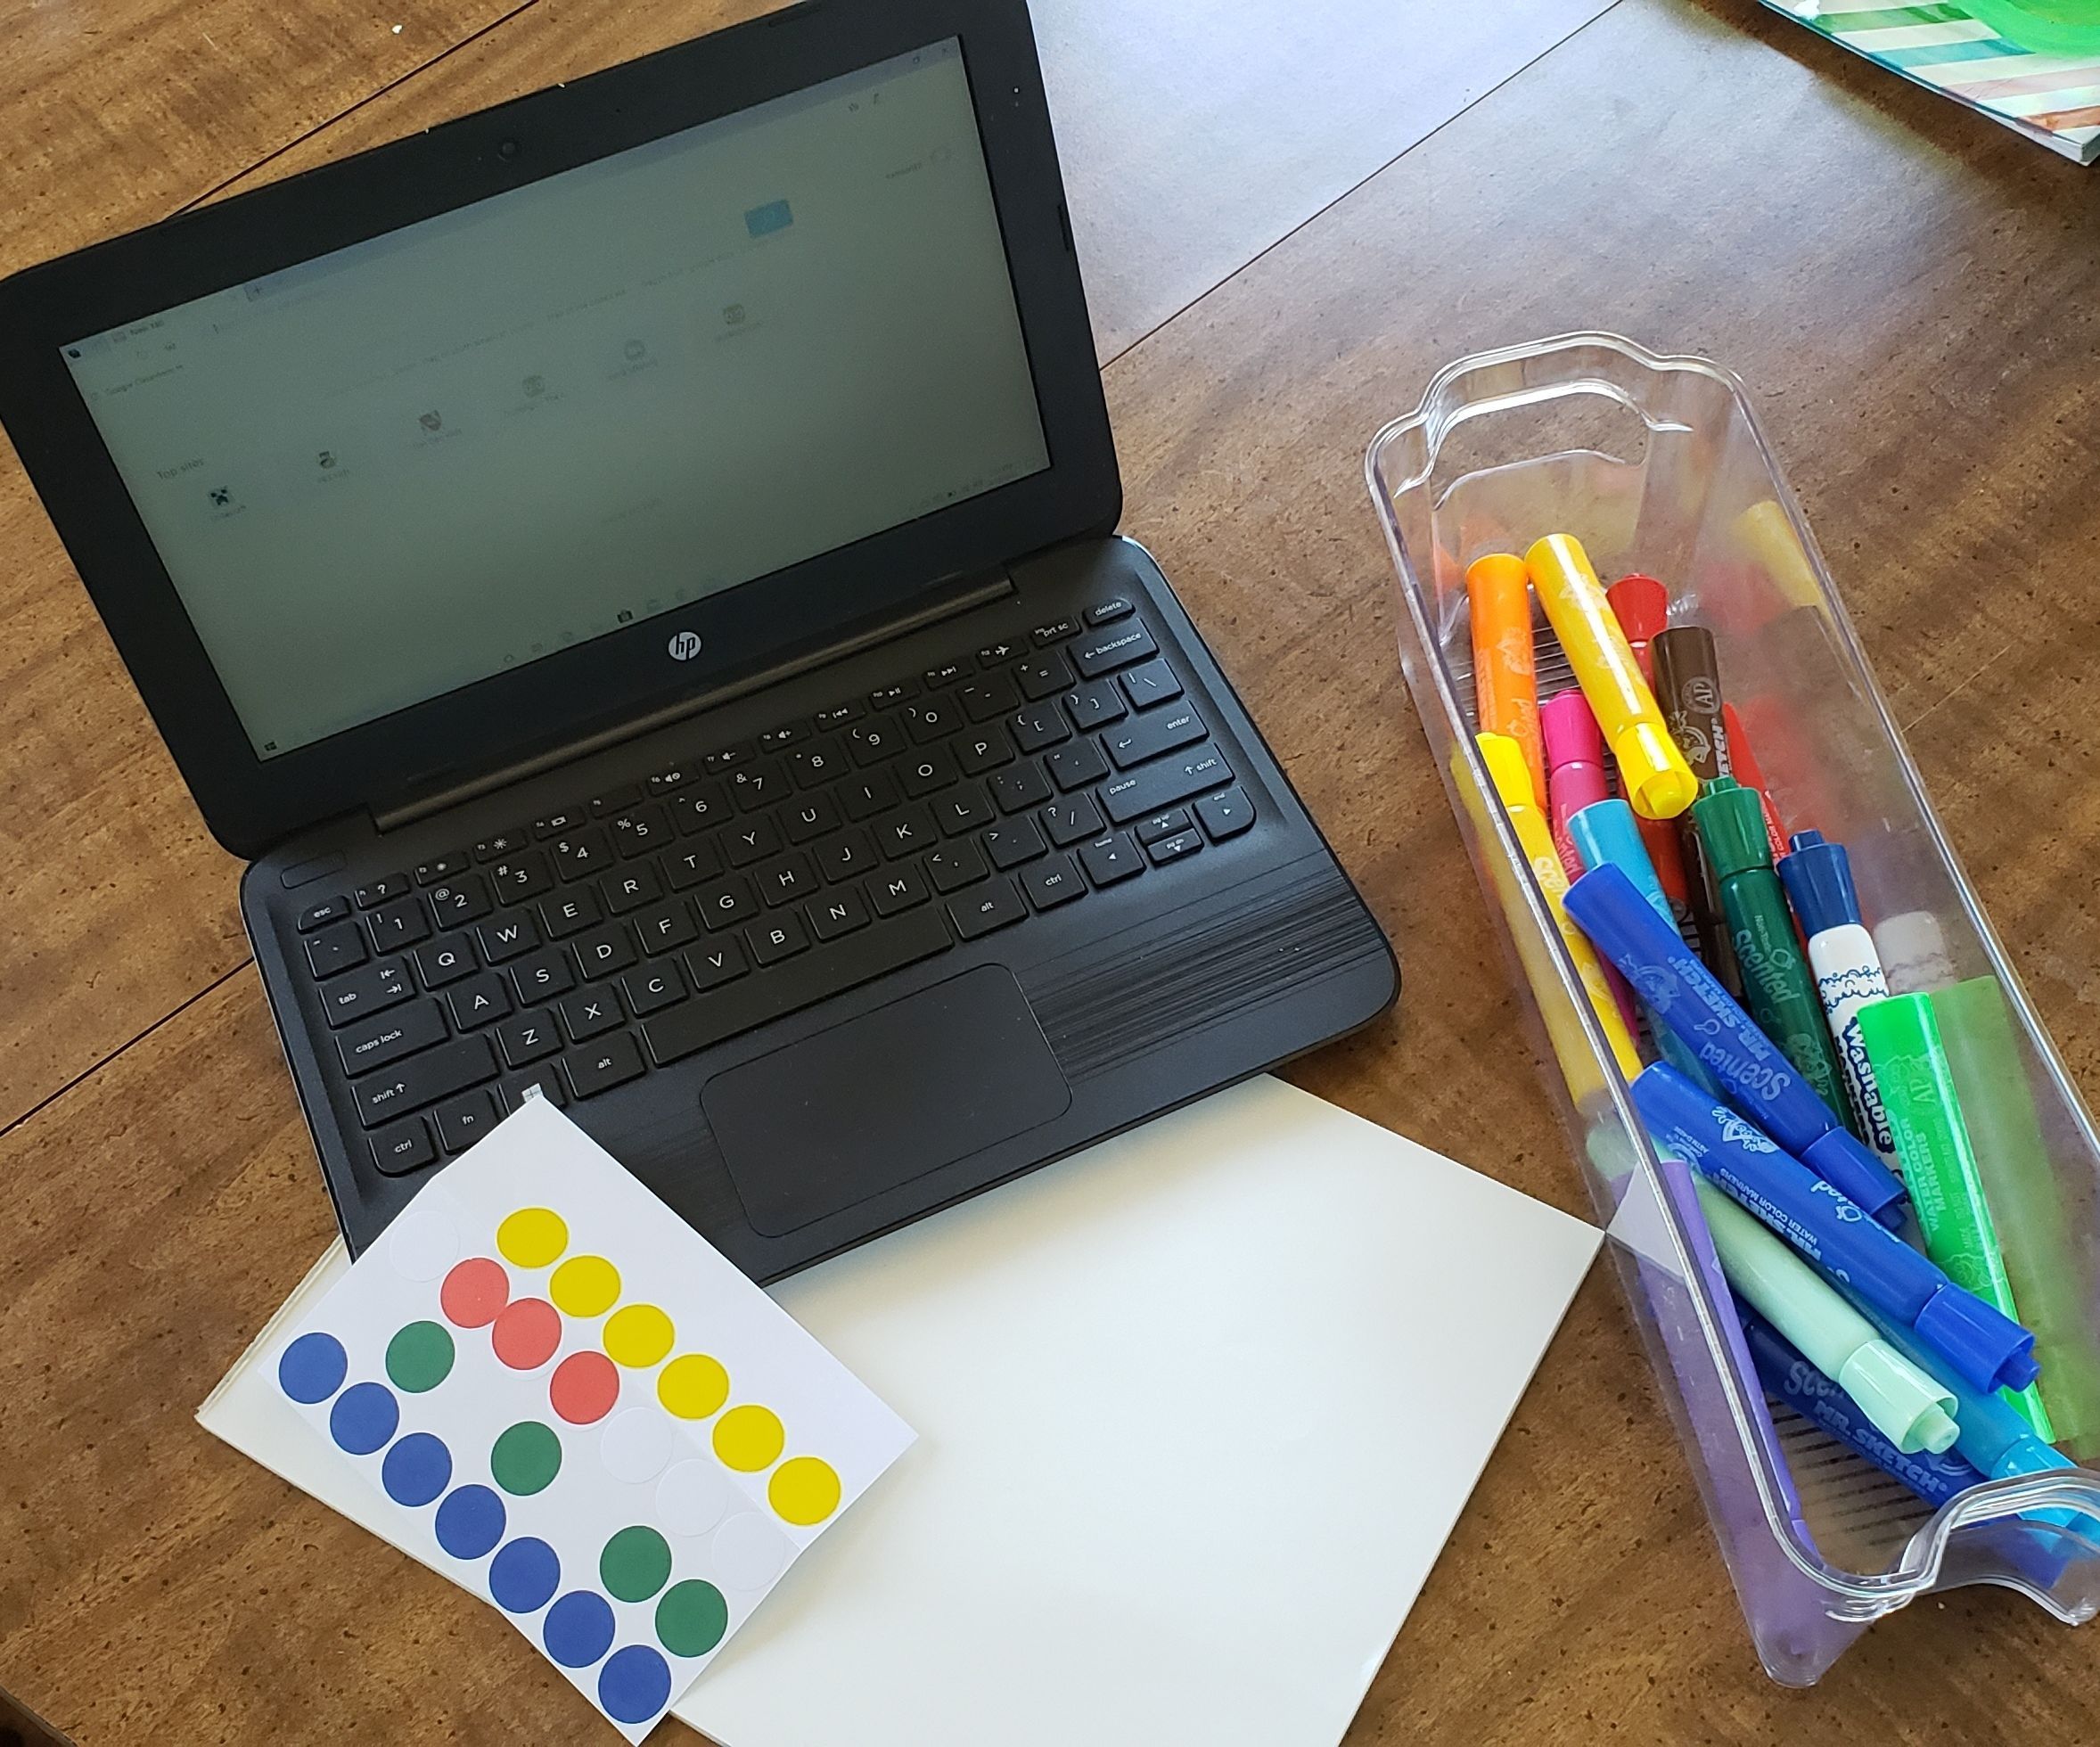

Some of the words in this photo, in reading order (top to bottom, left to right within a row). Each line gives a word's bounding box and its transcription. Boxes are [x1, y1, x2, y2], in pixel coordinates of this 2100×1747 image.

[1095, 602, 1123, 616] delete
[1043, 626, 1057, 637] prt
[1057, 622, 1069, 631] sc
[673, 632, 699, 660] hp
[1095, 632, 1142, 654] backspace
[1693, 682, 1713, 709] AP
[1167, 716, 1190, 729] enter
[868, 734, 881, 746] 9
[974, 742, 988, 756] P
[811, 755, 824, 767] 8
[1196, 759, 1217, 771] shift
[752, 777, 763, 791] 7
[1109, 779, 1136, 795] pause
[864, 786, 872, 799] I
[695, 800, 708, 813] 6
[955, 804, 970, 816] L
[801, 808, 816, 823] U
[636, 823, 649, 836] 5
[896, 824, 913, 839] K
[742, 831, 756, 845] Y
[577, 847, 589, 858] 4
[841, 847, 851, 861] J
[683, 855, 696, 869] T
[514, 870, 528, 883] 3
[778, 870, 795, 887] H
[1045, 874, 1062, 886] ctrl
[623, 879, 639, 894] R
[888, 879, 906, 896] M
[454, 894, 468, 907] 2
[718, 895, 734, 909] G
[980, 901, 994, 912] alt
[313, 906, 332, 918] esc
[562, 903, 578, 918] E
[829, 904, 847, 920] N
[394, 918, 403, 930] 1
[658, 918, 671, 934] F
[496, 924, 517, 942] W
[769, 930, 785, 945] B
[438, 952, 455, 966] Q
[595, 944, 612, 959] D
[708, 952, 722, 967] V
[536, 968, 550, 983] S
[648, 978, 664, 993] C
[339, 993, 357, 1005] tab
[1673, 958, 1740, 1029] SKETCH
[474, 995, 489, 1010] A
[584, 1003, 602, 1020] X
[355, 1035, 382, 1054] caps
[380, 1029, 402, 1044] lock
[521, 1028, 538, 1046] Z
[1737, 1024, 1772, 1062] MR.
[598, 1058, 611, 1069] alt
[1846, 1023, 1892, 1145] Washable
[372, 1088, 396, 1103] shift
[462, 1115, 474, 1125] fn
[394, 1139, 413, 1153] ctrl
[1899, 1117, 1924, 1172] COLOR
[1915, 1131, 1947, 1212] MARKERS
[1718, 1167, 1760, 1201] MARKERS
[1757, 1196, 1789, 1223] COLOR
[1918, 1175, 1940, 1233] WATER
[1786, 1218, 1818, 1245] WATER
[1813, 1400, 1852, 1437] MR.
[1852, 1428, 1940, 1493] SKETCH
